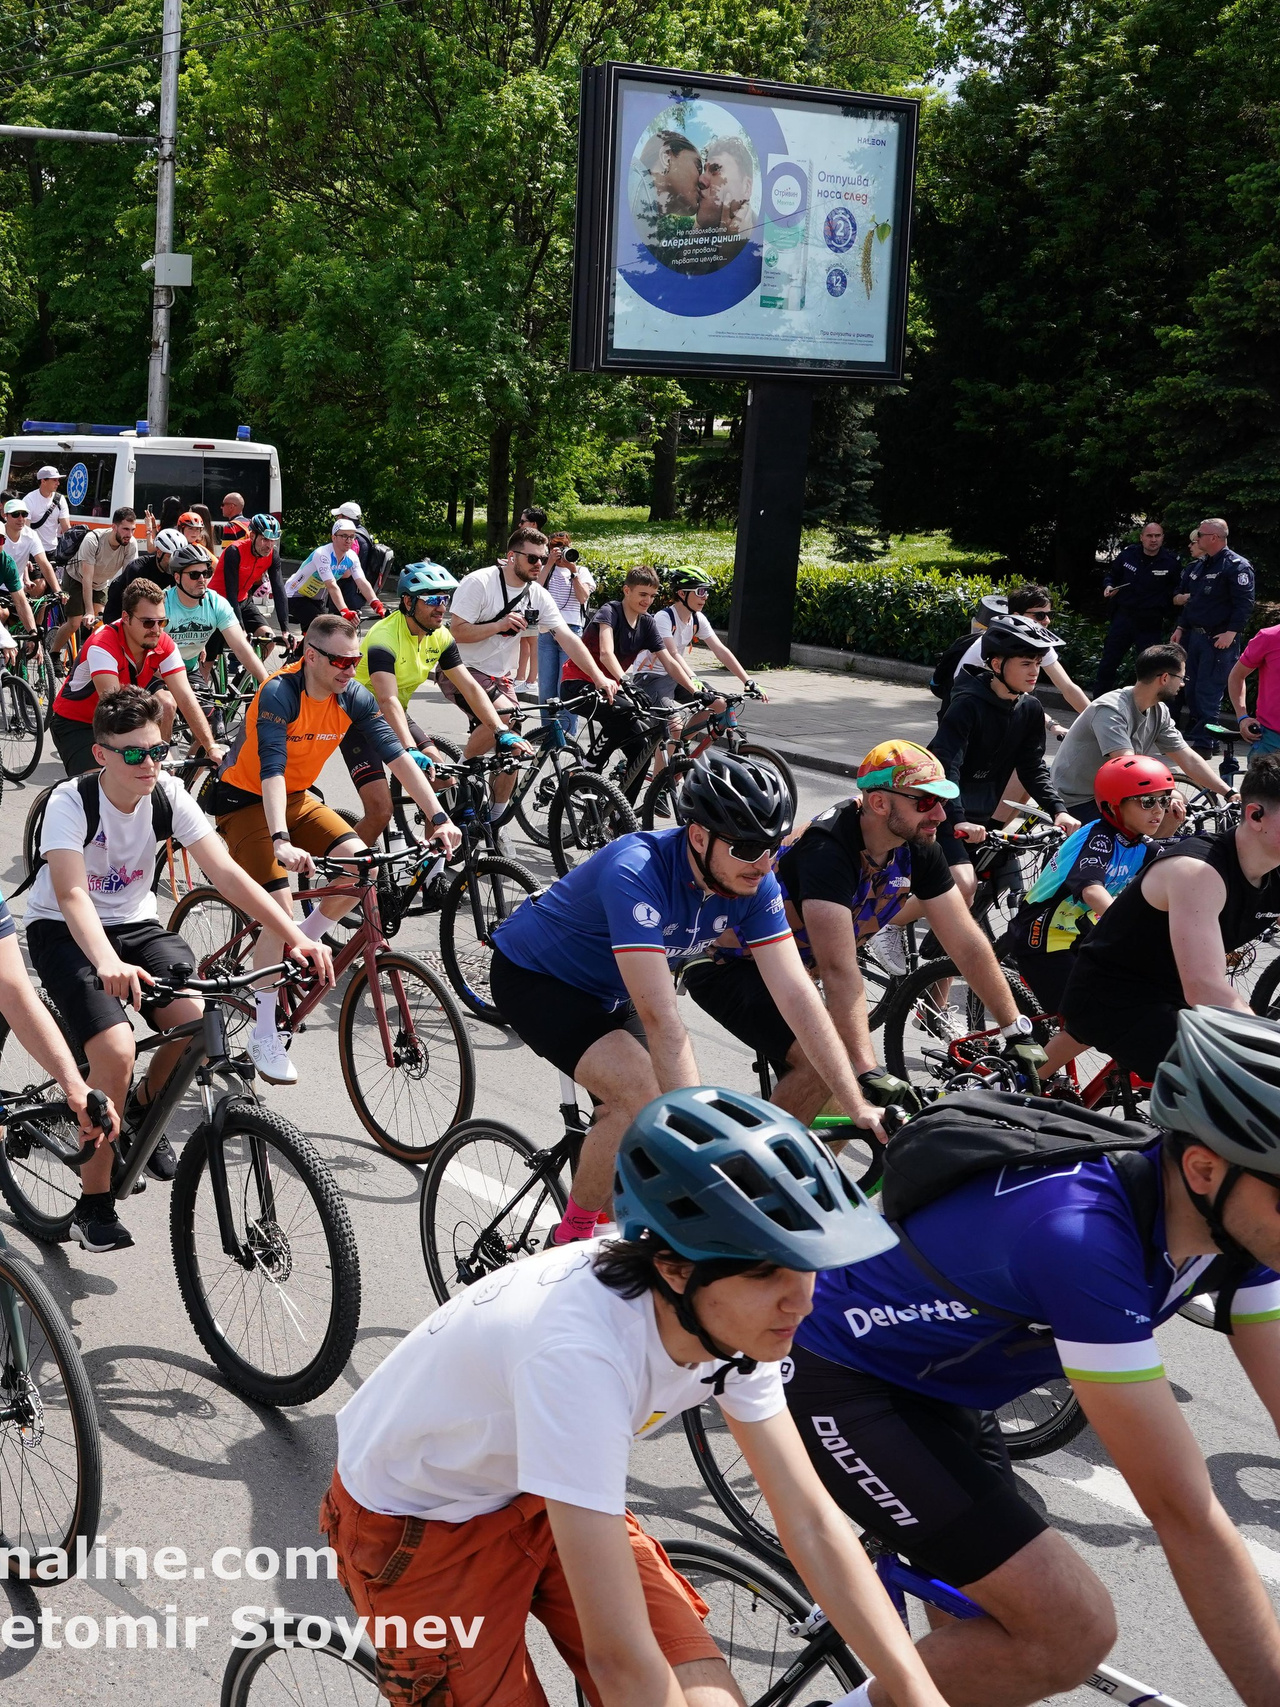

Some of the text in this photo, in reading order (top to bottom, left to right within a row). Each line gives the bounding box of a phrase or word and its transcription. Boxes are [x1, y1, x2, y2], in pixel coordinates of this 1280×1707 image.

[857, 136, 887, 147] HALEON
[818, 170, 869, 188] Отпушва
[817, 189, 868, 205] носа след
[661, 234, 741, 249] алергичен ринит
[692, 246, 718, 257] провали
[671, 257, 699, 267] първата
[811, 1416, 919, 1526] DOLTCINI
